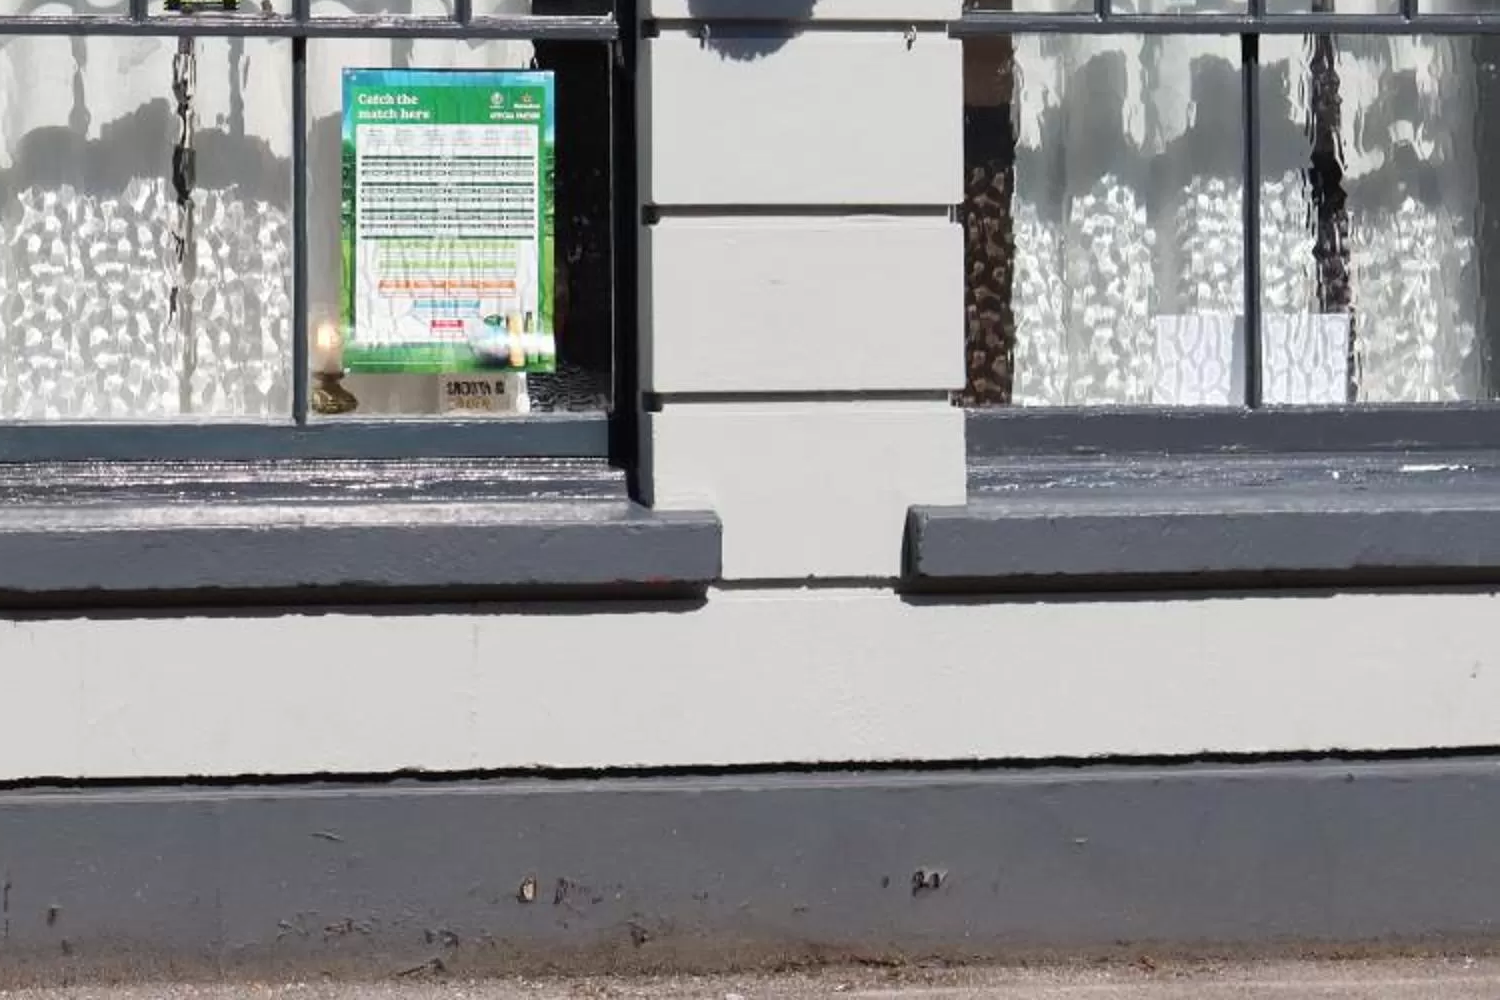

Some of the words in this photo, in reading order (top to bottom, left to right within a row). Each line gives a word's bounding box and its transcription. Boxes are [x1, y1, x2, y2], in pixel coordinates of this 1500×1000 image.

[358, 93, 394, 105] Catch
[396, 93, 419, 105] the
[358, 108, 397, 120] match
[400, 108, 431, 120] here
